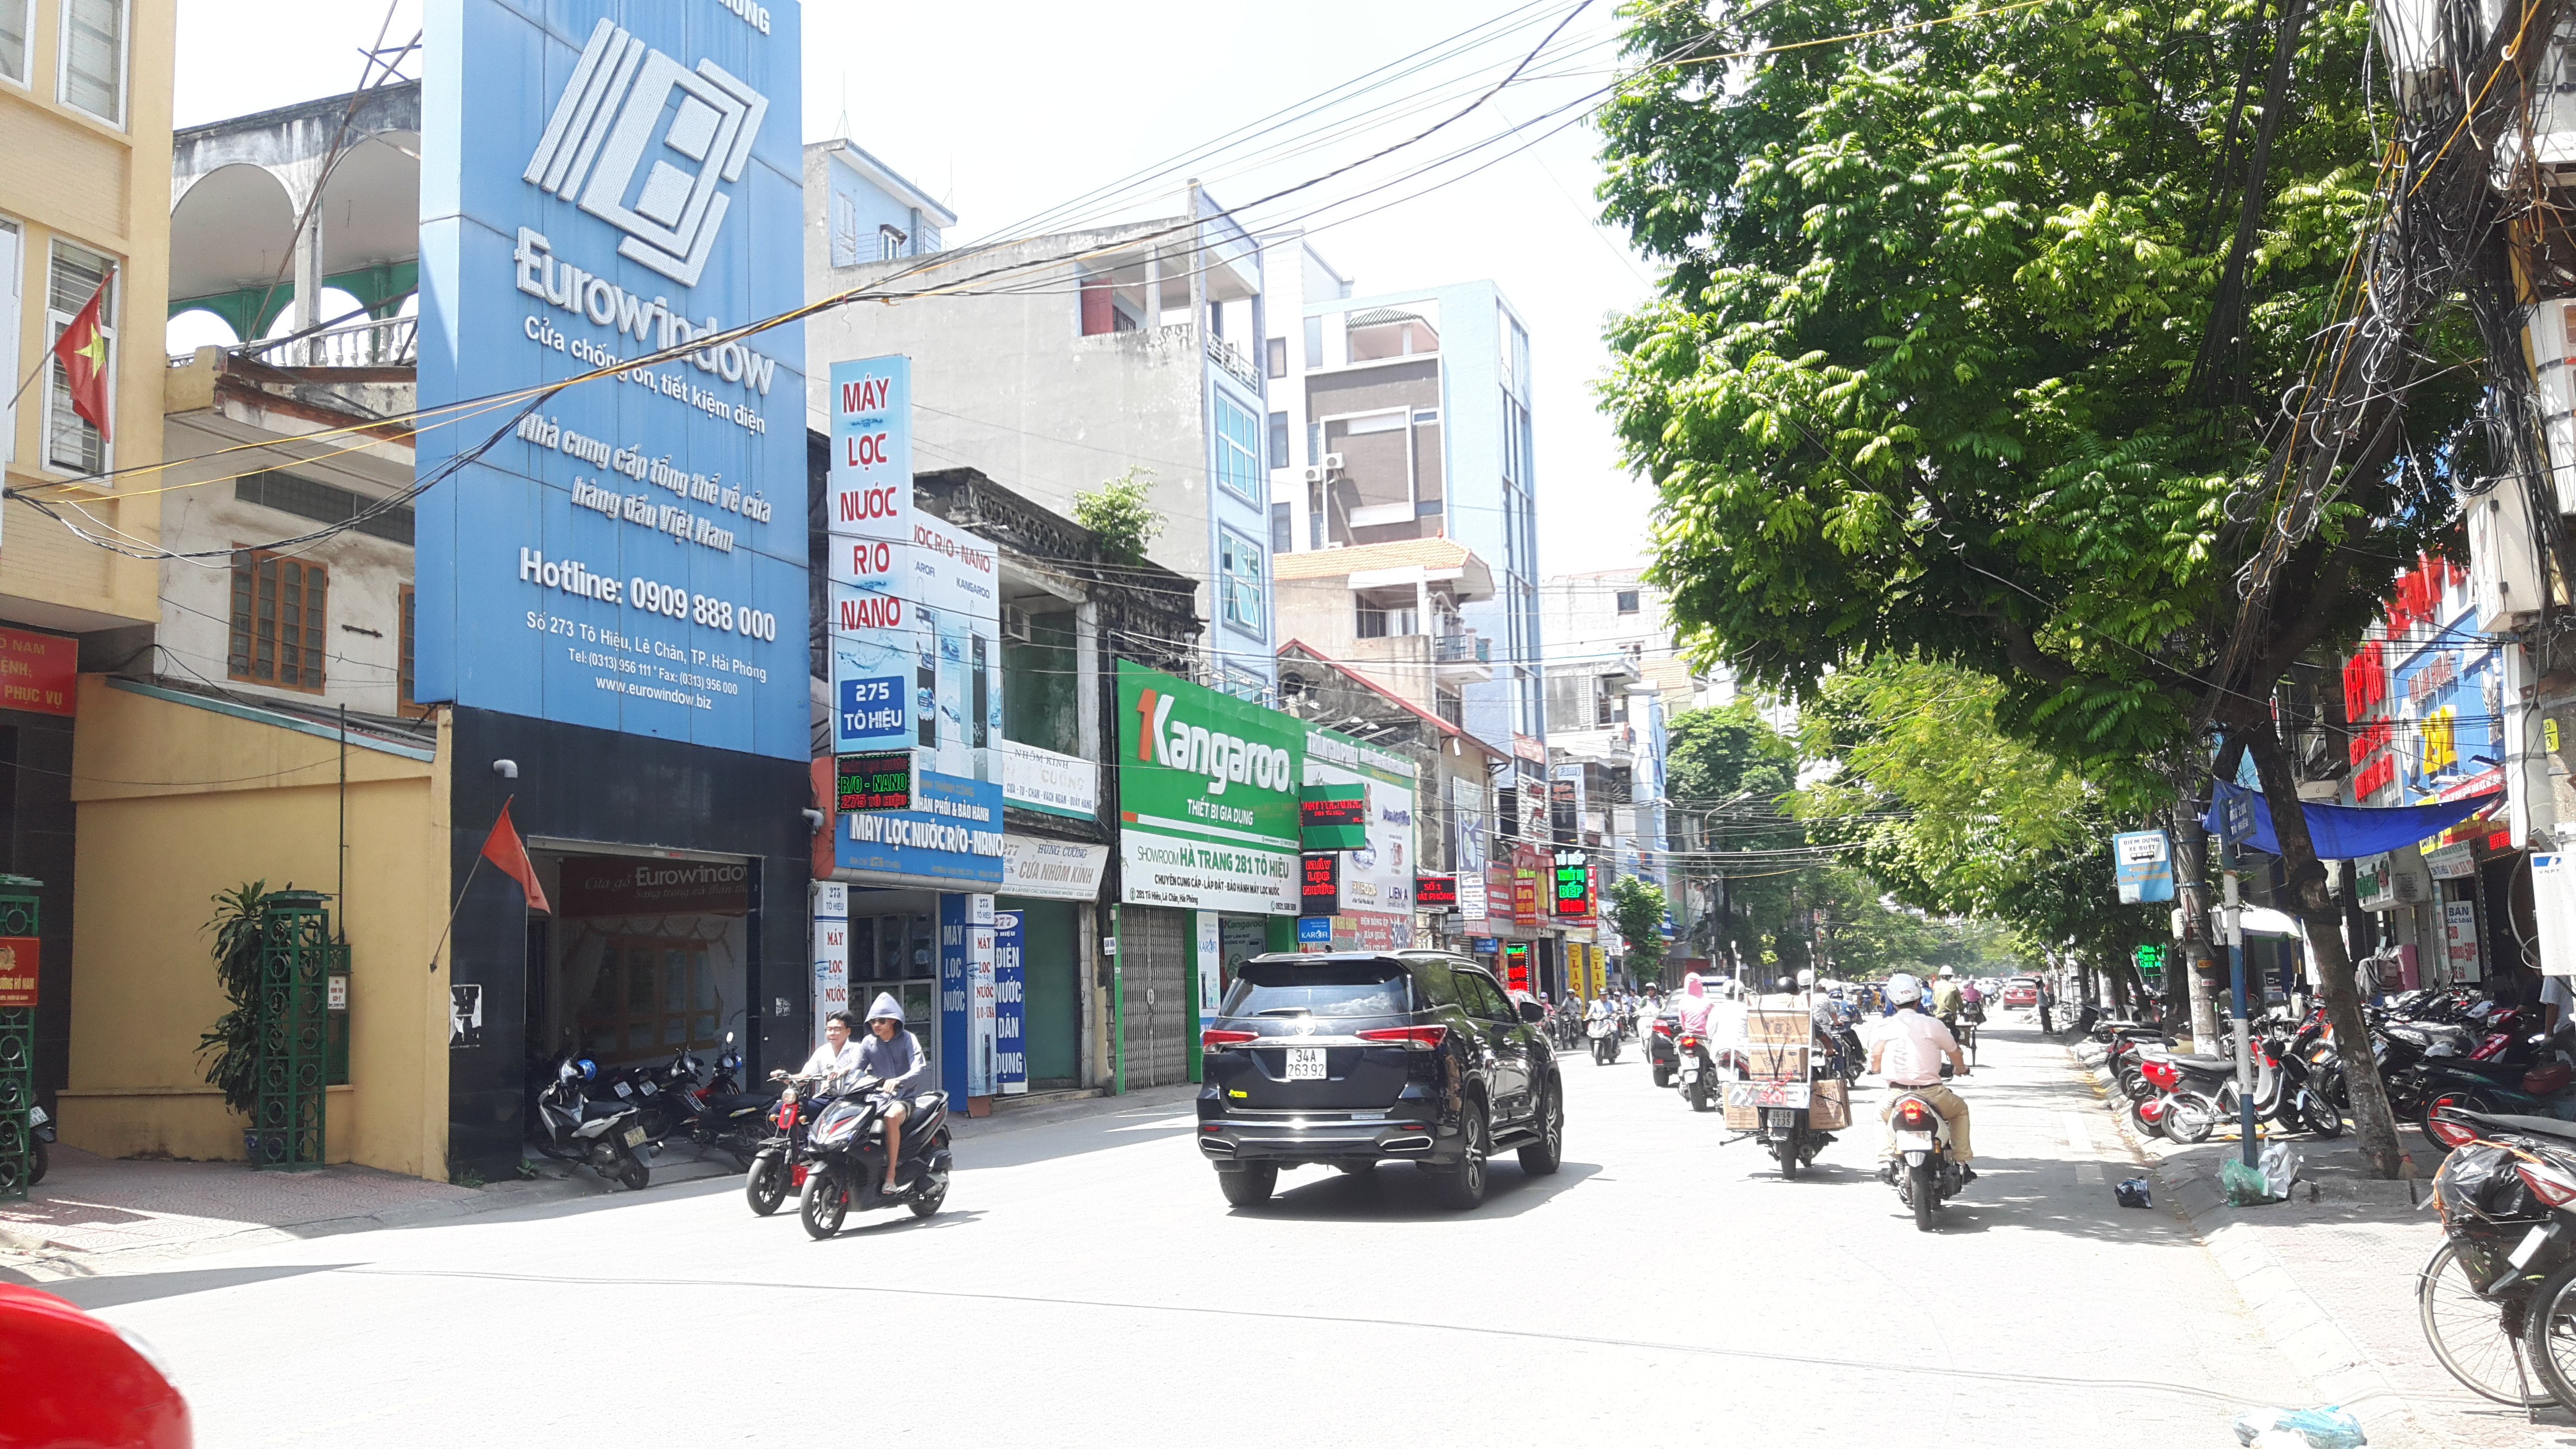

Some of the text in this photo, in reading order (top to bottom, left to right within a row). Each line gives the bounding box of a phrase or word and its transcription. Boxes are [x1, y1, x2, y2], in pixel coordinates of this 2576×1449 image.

[514, 226, 774, 395] Eurowindow
[524, 315, 564, 352] Cửa
[660, 374, 688, 402] tiết
[692, 385, 730, 418] kiệm
[734, 404, 765, 435] điện
[842, 373, 889, 413] MÁY
[848, 433, 887, 470] LỌC
[518, 413, 771, 523] Nhà cung cấp tổng thể về cửa
[840, 482, 897, 522] NƯỚC
[571, 476, 734, 552] hàng đầu Việt Nam
[853, 542, 890, 575] R/O
[935, 533, 991, 573] R/O NANO
[915, 560, 990, 599] AROFI KANGAROO
[520, 547, 776, 642] Hotline: 0909 888 000
[841, 597, 901, 631] NANO
[526, 611, 766, 683] Số 273 Tô Hiệu, Lê Chân, TP. Hải Phòng
[569, 647, 738, 695] Tel: (0313) 956 111 Fax: (0313) 956 000
[4, 685, 63, 708] PHỤC VỤ
[595, 676, 712, 710] www.eurowindow.biz
[856, 682, 890, 702] 275
[844, 707, 902, 732] TÔ HIỆU
[1137, 688, 1290, 795] Kangaroo
[1015, 749, 1068, 770] NHÔM KÍNH
[841, 775, 863, 794] R/O
[873, 773, 907, 793] NANO
[841, 794, 867, 808] 275
[868, 794, 882, 807] TÔ
[918, 794, 989, 822] HÂN PHỐI & BẢO HÀNH
[1187, 795, 1210, 818] THIẾT
[1211, 801, 1219, 822] BỊ
[1219, 805, 1233, 822] GIA
[1233, 808, 1253, 828] DỤNG
[884, 817, 946, 851] LỌC NƯỚC
[1040, 861, 1071, 882] NHÔM
[1071, 863, 1094, 884] KÍNH
[1138, 842, 1289, 883] SHOWROOM HÀ TRANG 281 TÔ HIỆU
[1305, 857, 1332, 870] MÁY
[636, 865, 747, 887] Eurowindo
[1154, 874, 1177, 887] CHUYÊN
[1177, 876, 1190, 888] CUNG
[1191, 874, 1201, 888] CẤP
[1204, 875, 1214, 890] LẮP
[1214, 879, 1224, 893] ĐẶT
[1227, 879, 1237, 892] BẢO
[1237, 880, 1249, 893] HÀNH
[1249, 881, 1259, 894] MÁY
[1268, 883, 1280, 896] NƯỚC
[1308, 872, 1329, 883] LỌC
[830, 887, 840, 899] 275
[1136, 889, 1144, 898] 281
[1145, 890, 1150, 899] Tô
[1303, 883, 1336, 896] NƯỚC
[1517, 887, 1533, 899] in
[1559, 880, 1583, 898] BẾP
[826, 901, 844, 912] TÔ HIỆU
[979, 898, 988, 908] 275
[2449, 905, 2469, 917] BÁN
[944, 918, 963, 946] MÁY
[1224, 920, 1263, 930] Kangaroo
[1301, 929, 1328, 939] KAROFI
[827, 928, 844, 946] MÁY
[977, 934, 991, 949] MÁY
[1198, 937, 1218, 953] KAROFI
[828, 959, 842, 977] LỌC
[978, 961, 991, 977] LỌC
[996, 943, 1020, 973] ĐIỆN
[945, 957, 962, 983] LỌC
[825, 984, 846, 1002] NƯỚC
[944, 986, 965, 1012] NƯỚC
[976, 983, 994, 998] NƯỚC
[996, 976, 1022, 1003] NƯỚC
[986, 1006, 995, 1018] USA
[998, 1013, 1019, 1039] DÂN
[997, 1052, 1022, 1079] DỤNG
[1296, 1049, 1317, 1063] 34A
[1288, 1063, 1325, 1077] 263.92
